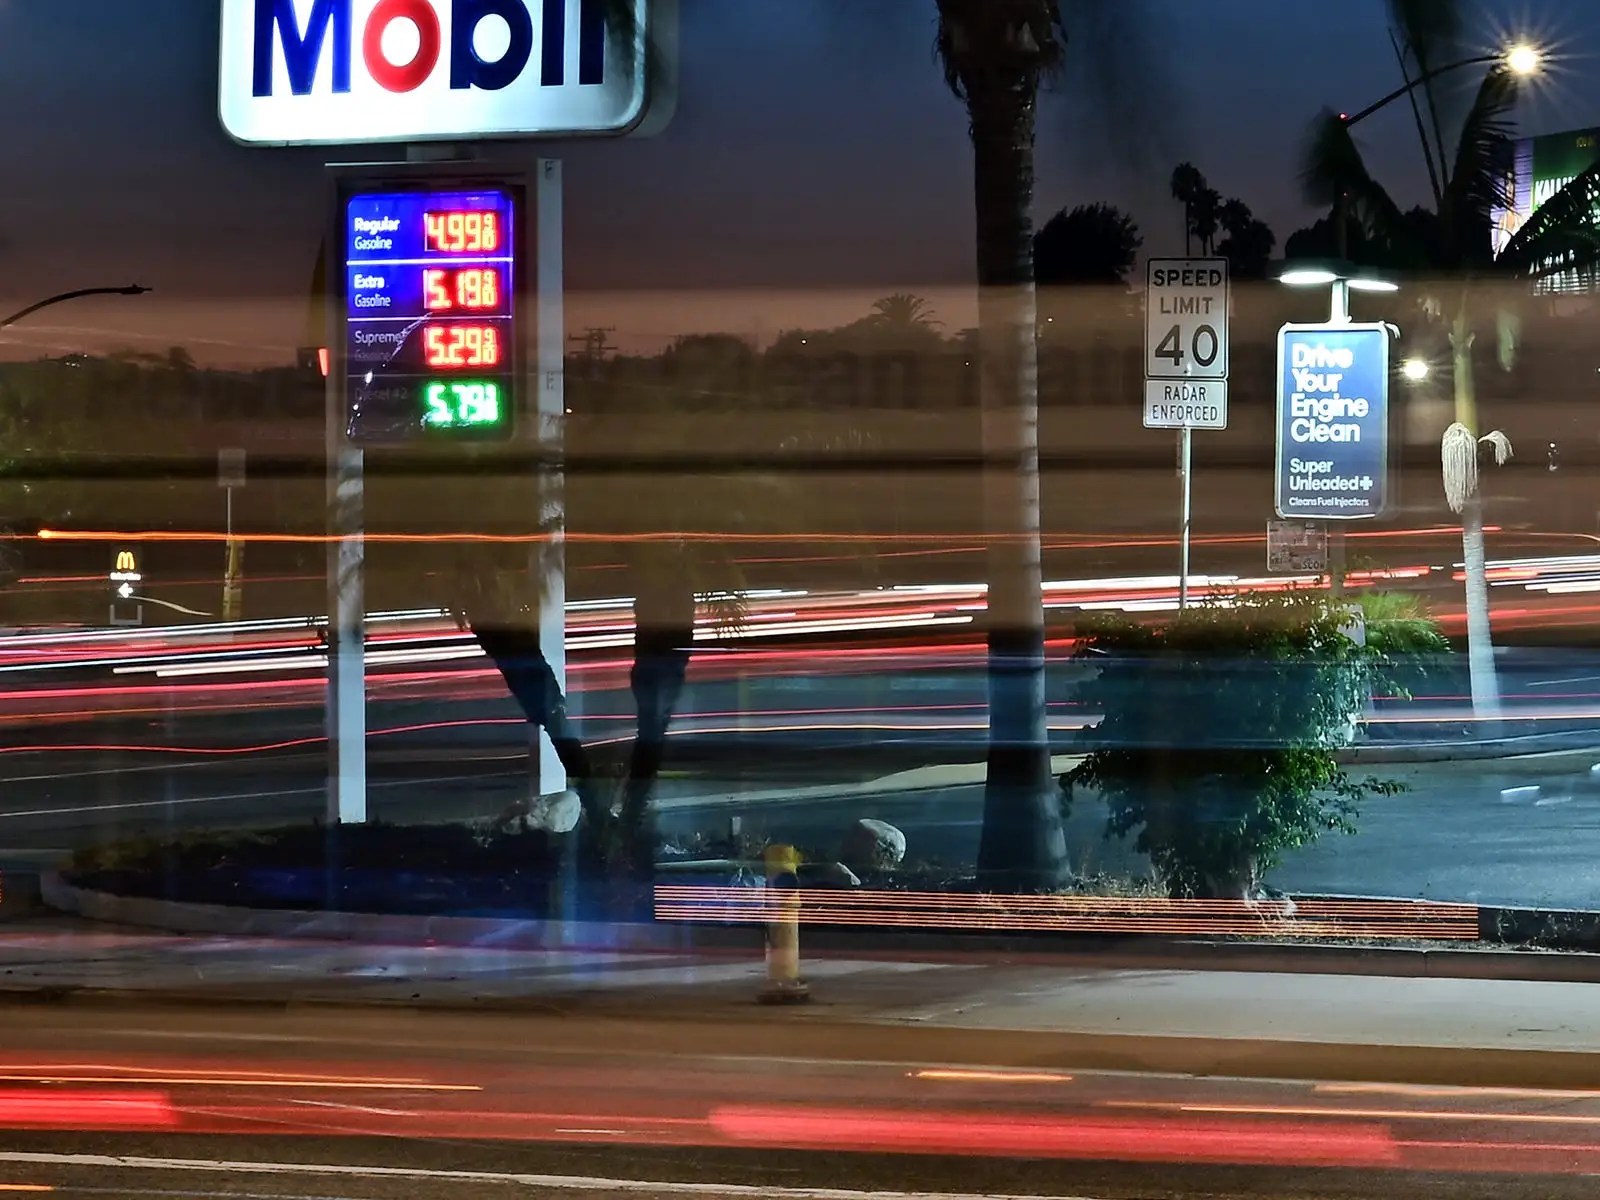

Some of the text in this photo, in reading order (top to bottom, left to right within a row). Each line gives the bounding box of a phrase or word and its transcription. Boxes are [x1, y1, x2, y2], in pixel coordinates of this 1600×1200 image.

[354, 216, 400, 235] Regular
[354, 236, 392, 250] Gasoline
[354, 274, 385, 289] Extra
[1153, 269, 1222, 287] SPEED
[354, 294, 392, 308] Gasoline
[1160, 297, 1213, 314] LIMIT
[354, 330, 405, 346] Supreme
[1155, 324, 1218, 367] 40
[1291, 343, 1354, 368] Drive
[1291, 368, 1343, 392] Your
[1164, 386, 1207, 401] RADAR
[1152, 405, 1218, 421] ENFORCED
[1291, 393, 1370, 423] Engine
[1290, 418, 1361, 442] Clean
[1290, 458, 1334, 476] Super
[1289, 497, 1370, 508] Cleans Fuel Injectors
